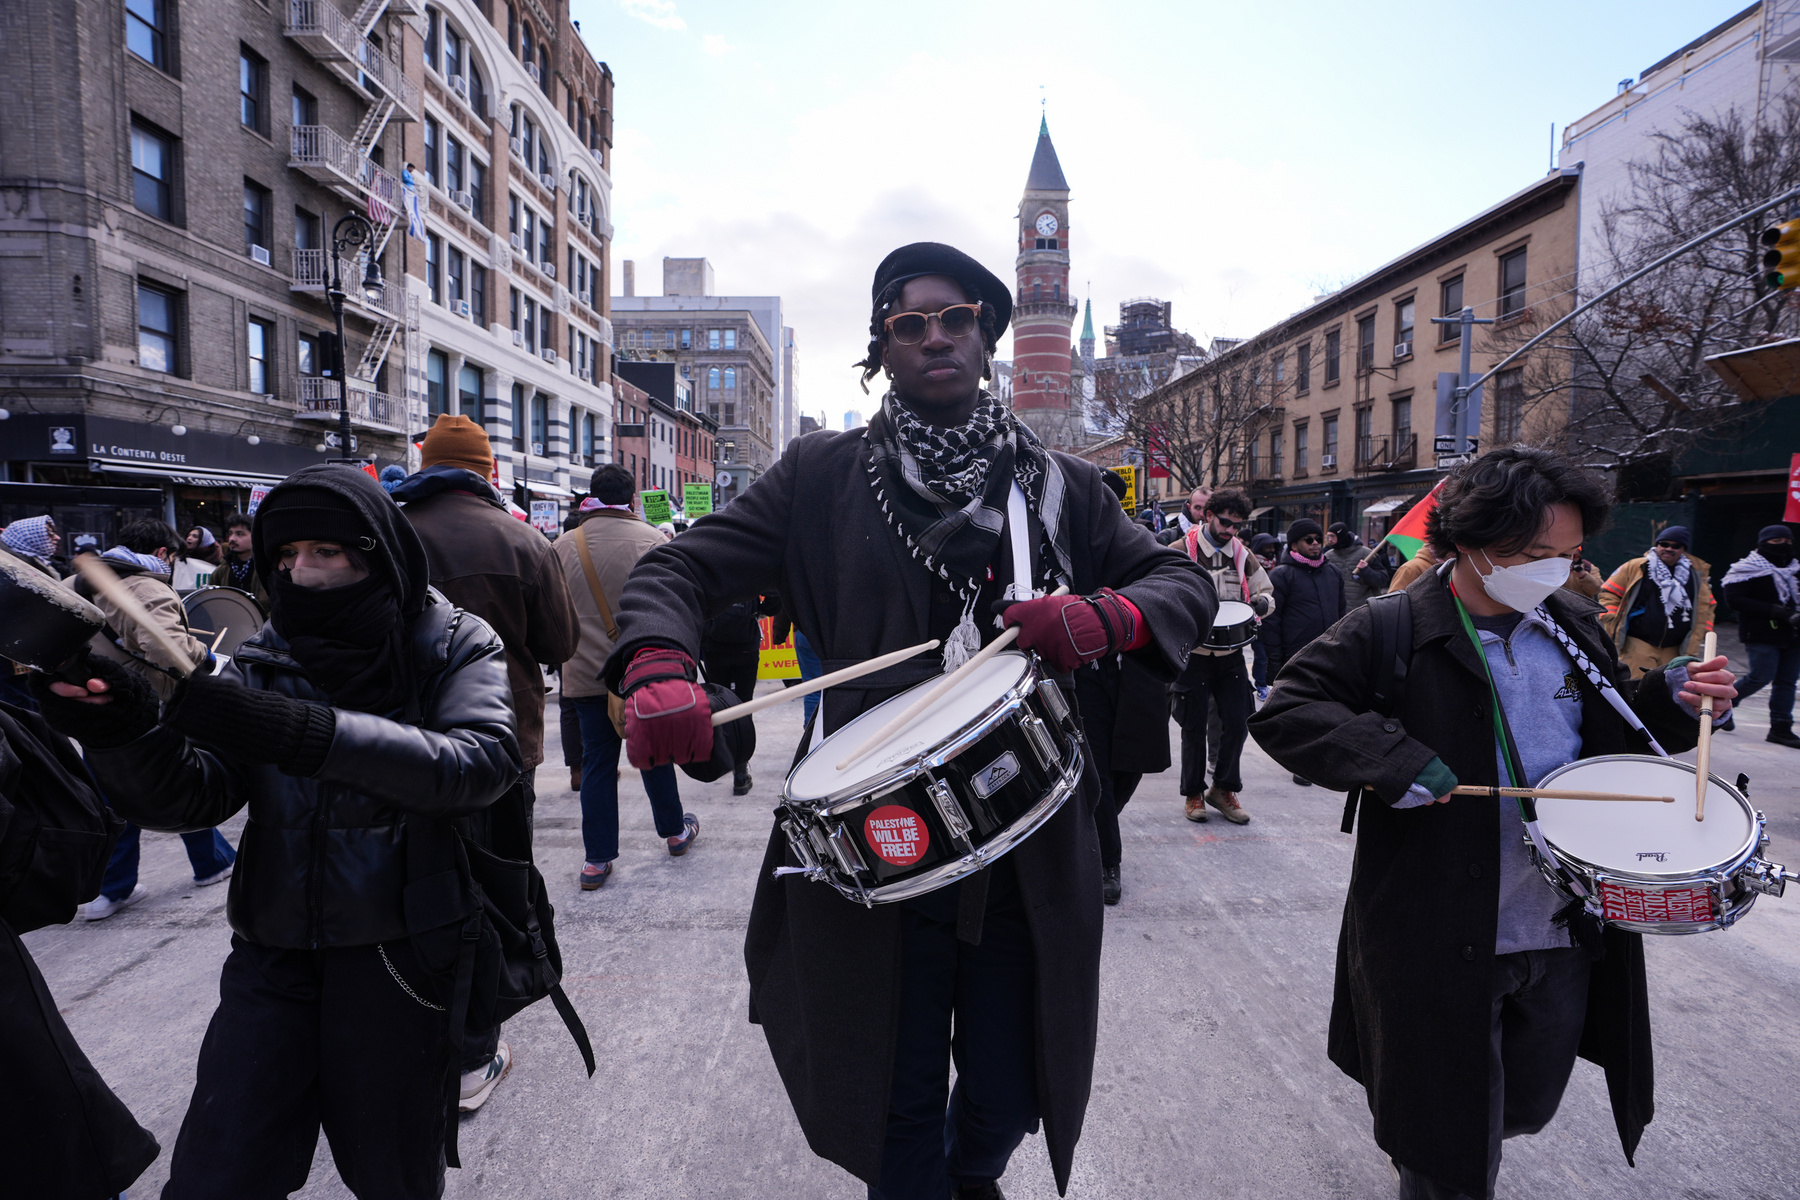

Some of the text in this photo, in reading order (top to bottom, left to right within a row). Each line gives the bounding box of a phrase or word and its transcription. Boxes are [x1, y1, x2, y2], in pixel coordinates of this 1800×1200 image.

[308, 401, 315, 410] W
[328, 400, 337, 410] ST
[93, 443, 186, 463] LA CONTENTA OESTE
[647, 495, 662, 503] STOP
[869, 816, 917, 829] PALESTINE
[871, 827, 920, 843] WILL BE
[880, 842, 917, 857] FREE!
[1637, 852, 1670, 863] Pearl
[1603, 886, 1628, 919] TATE
